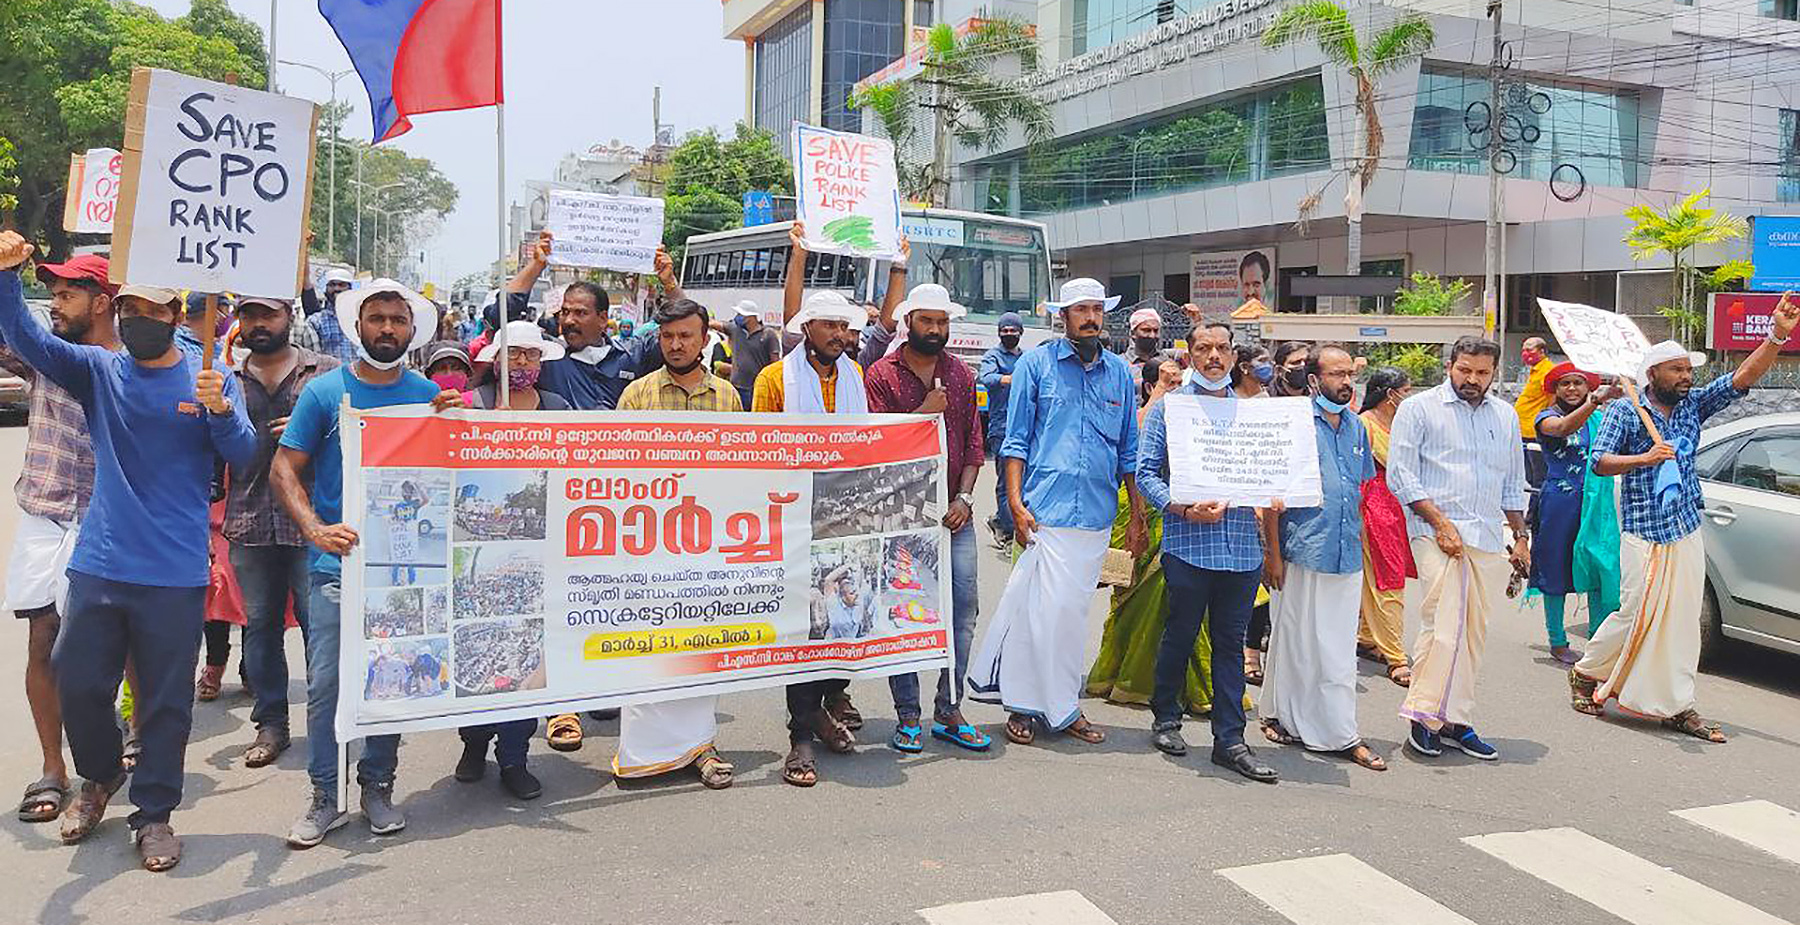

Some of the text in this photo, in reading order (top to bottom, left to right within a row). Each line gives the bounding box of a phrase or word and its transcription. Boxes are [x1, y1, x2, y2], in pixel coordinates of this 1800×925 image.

[177, 93, 276, 152] SAVE
[808, 136, 878, 167] SAVE
[169, 149, 288, 201] CPO
[815, 160, 869, 181] POLICE
[813, 178, 866, 198] RANK
[821, 193, 858, 212] LIST
[170, 199, 255, 234] RANK
[177, 235, 245, 269] LIST
[1746, 314, 1776, 325] KERA
[1746, 324, 1776, 334] BAN
[461, 426, 551, 443] പി.എസ്.സി
[720, 429, 757, 446] ഉടൻ
[761, 429, 825, 445] നിയമനം
[460, 445, 568, 464] സർക്കാരിന്റെ
[573, 448, 641, 463] യുവജന
[645, 448, 701, 462] വഞ്ചന
[565, 473, 686, 500] ലോംഗ്
[566, 492, 799, 564] മാർച്ച്
[567, 565, 785, 587] ആത്മഹത്യ ചെയ്ത അനുവിന്റെ
[624, 583, 729, 601] മണ്ഡപത്തിൽ
[733, 583, 785, 598] നിന്നും
[567, 596, 785, 627] സെക്രട്ടേറിയറ്റിലേക്ക്
[601, 629, 763, 654] മാർച്ച് 31, ഏപ്രിൽ 1
